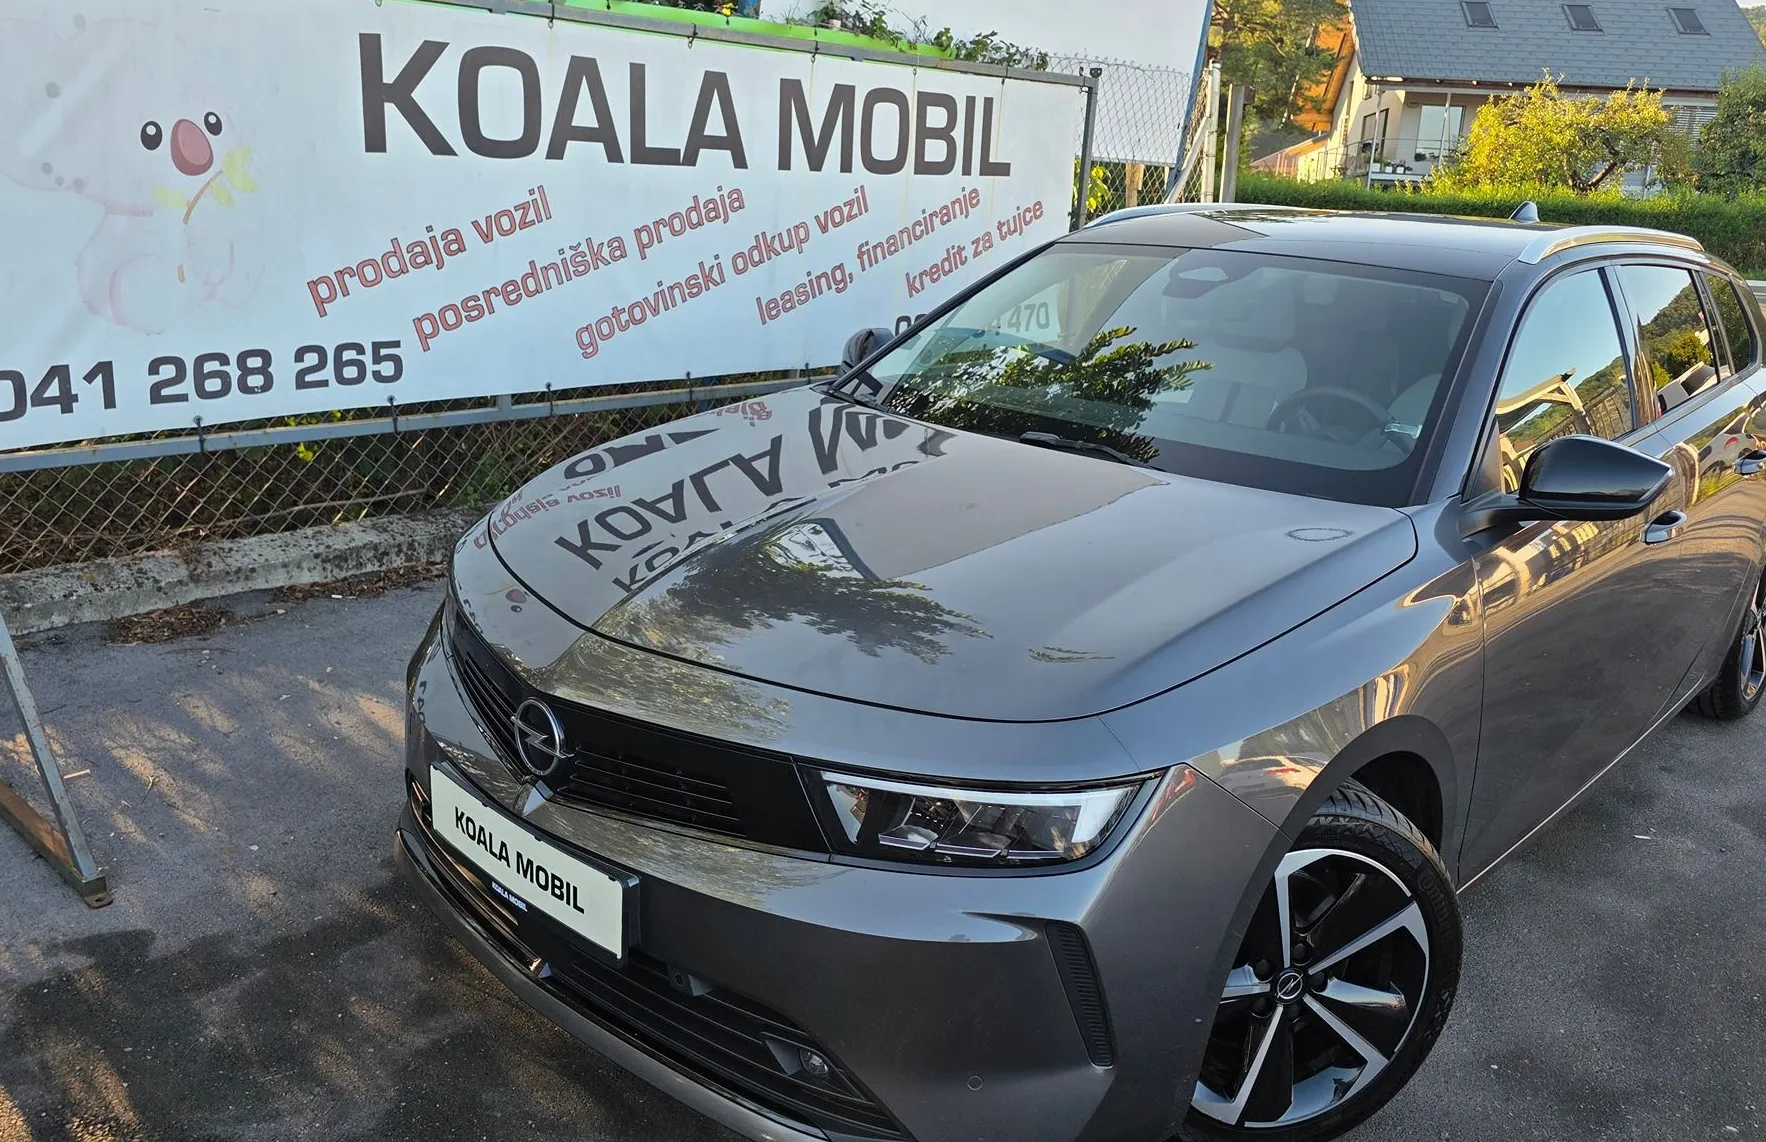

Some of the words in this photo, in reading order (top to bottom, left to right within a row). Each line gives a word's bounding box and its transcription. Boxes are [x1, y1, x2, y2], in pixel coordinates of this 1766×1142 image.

[359, 33, 748, 170] KOALA
[777, 78, 1011, 177] MOBIL
[307, 224, 467, 317] prodaja
[472, 185, 552, 244] vozil
[412, 236, 628, 352] posredniška
[633, 186, 746, 257] prodaja
[575, 255, 724, 360] gotovinski
[732, 222, 811, 276] odkup
[814, 185, 870, 235] vozil
[756, 260, 854, 325] leasing,
[856, 186, 982, 273] financiranje
[904, 244, 968, 298] kredit
[971, 232, 994, 259] za
[996, 199, 1044, 244] tujce
[0, 361, 117, 422] 041
[147, 348, 274, 405] 268
[294, 340, 404, 390] 265
[1008, 301, 1050, 333] 470
[454, 805, 511, 869] KOALA
[516, 850, 585, 915] MOBIL
